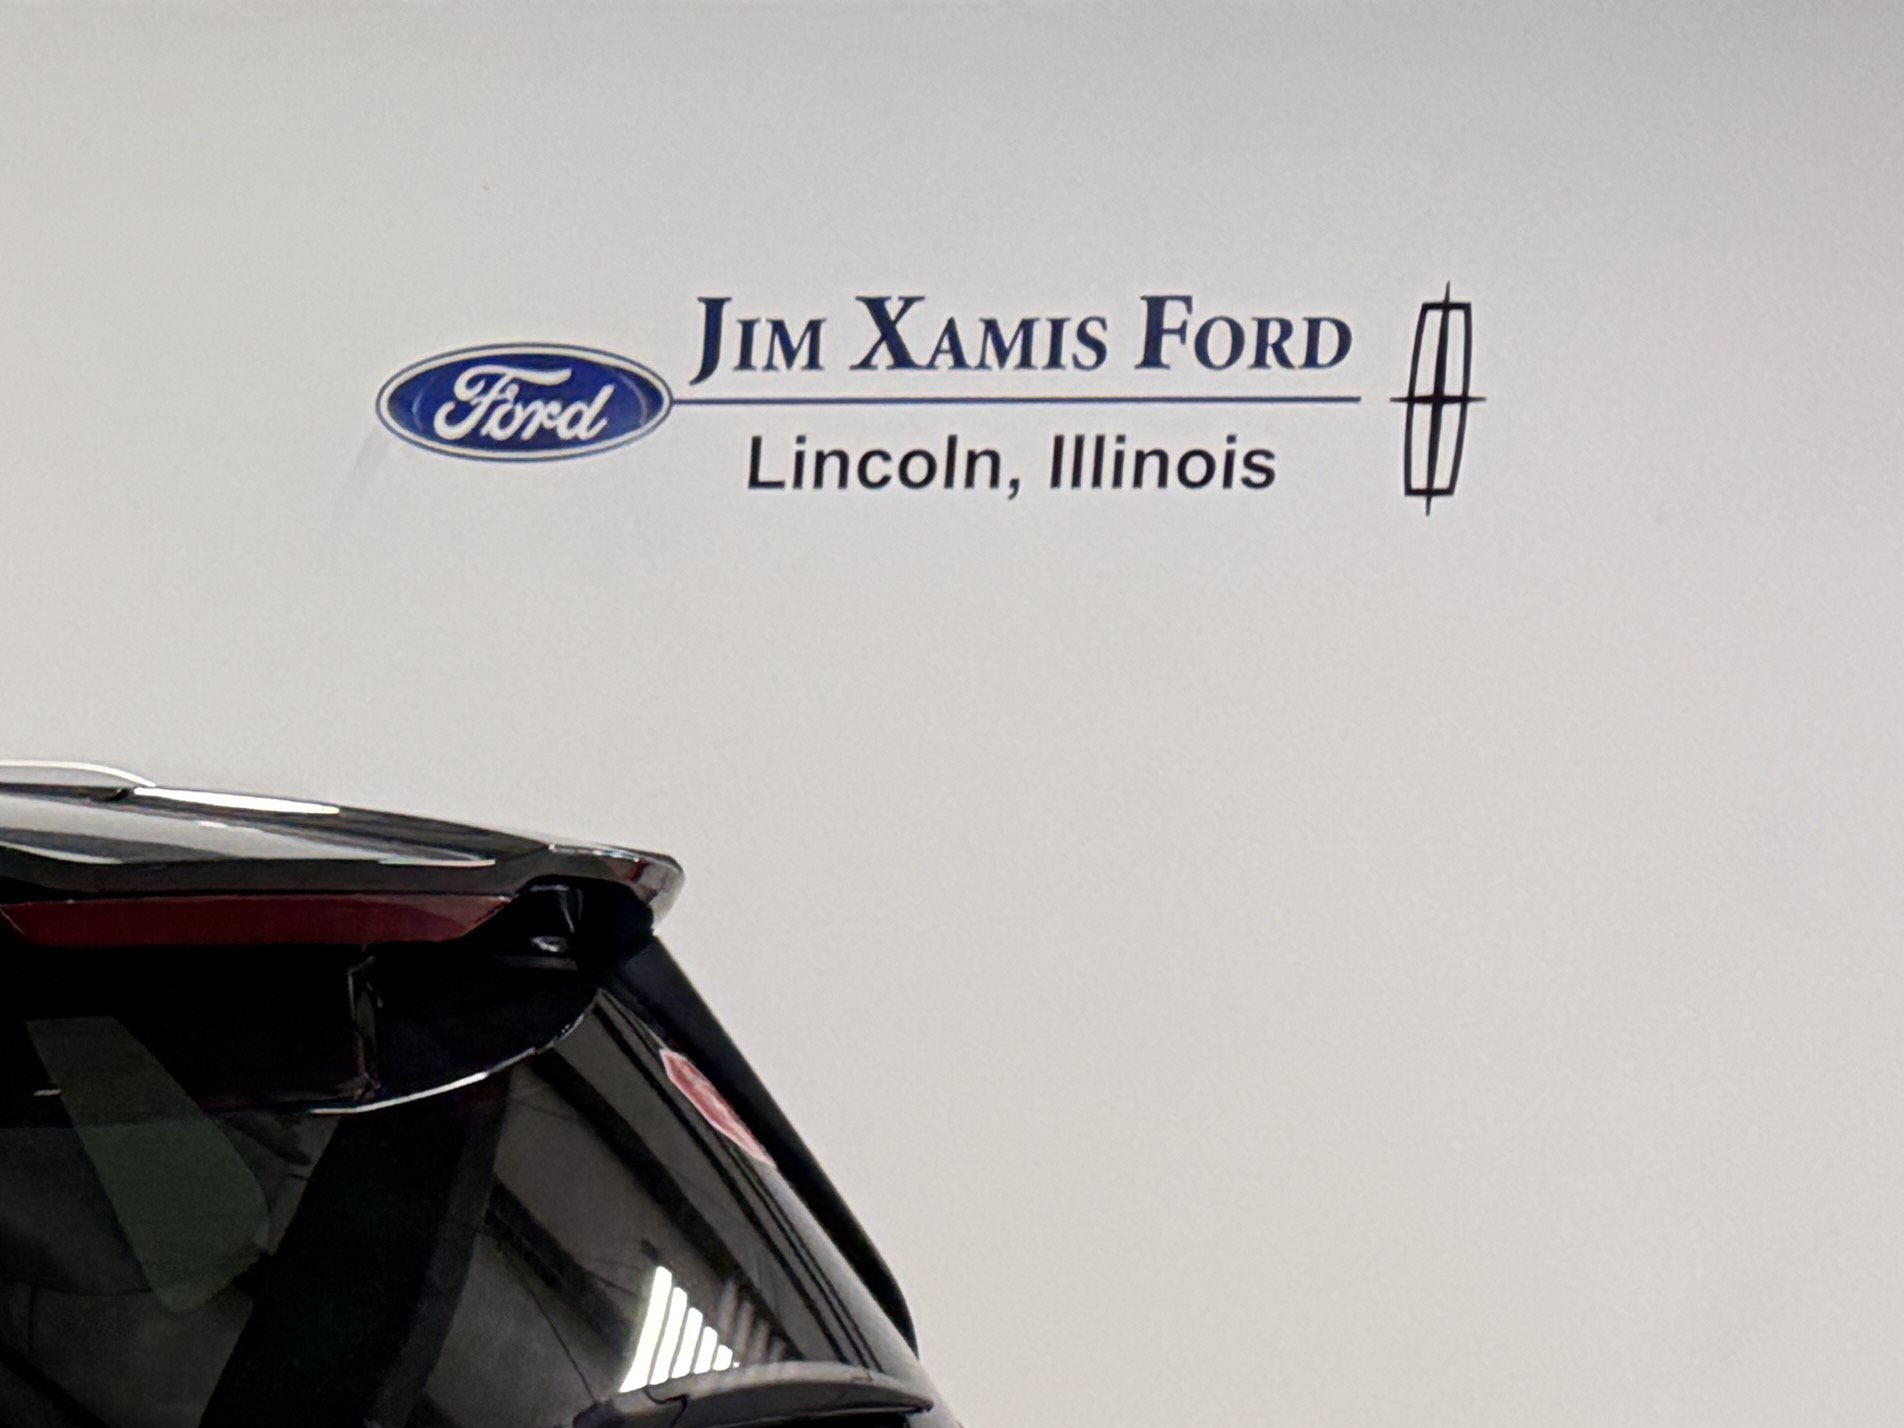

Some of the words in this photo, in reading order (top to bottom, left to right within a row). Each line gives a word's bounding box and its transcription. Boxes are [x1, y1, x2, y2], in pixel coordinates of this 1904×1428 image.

[688, 295, 827, 387] JIM
[848, 294, 1109, 373] XAMIS
[1133, 293, 1354, 372] FORD
[432, 363, 614, 442] Ford
[746, 433, 1021, 502] Lincoln,
[1048, 432, 1277, 491] Illinois
